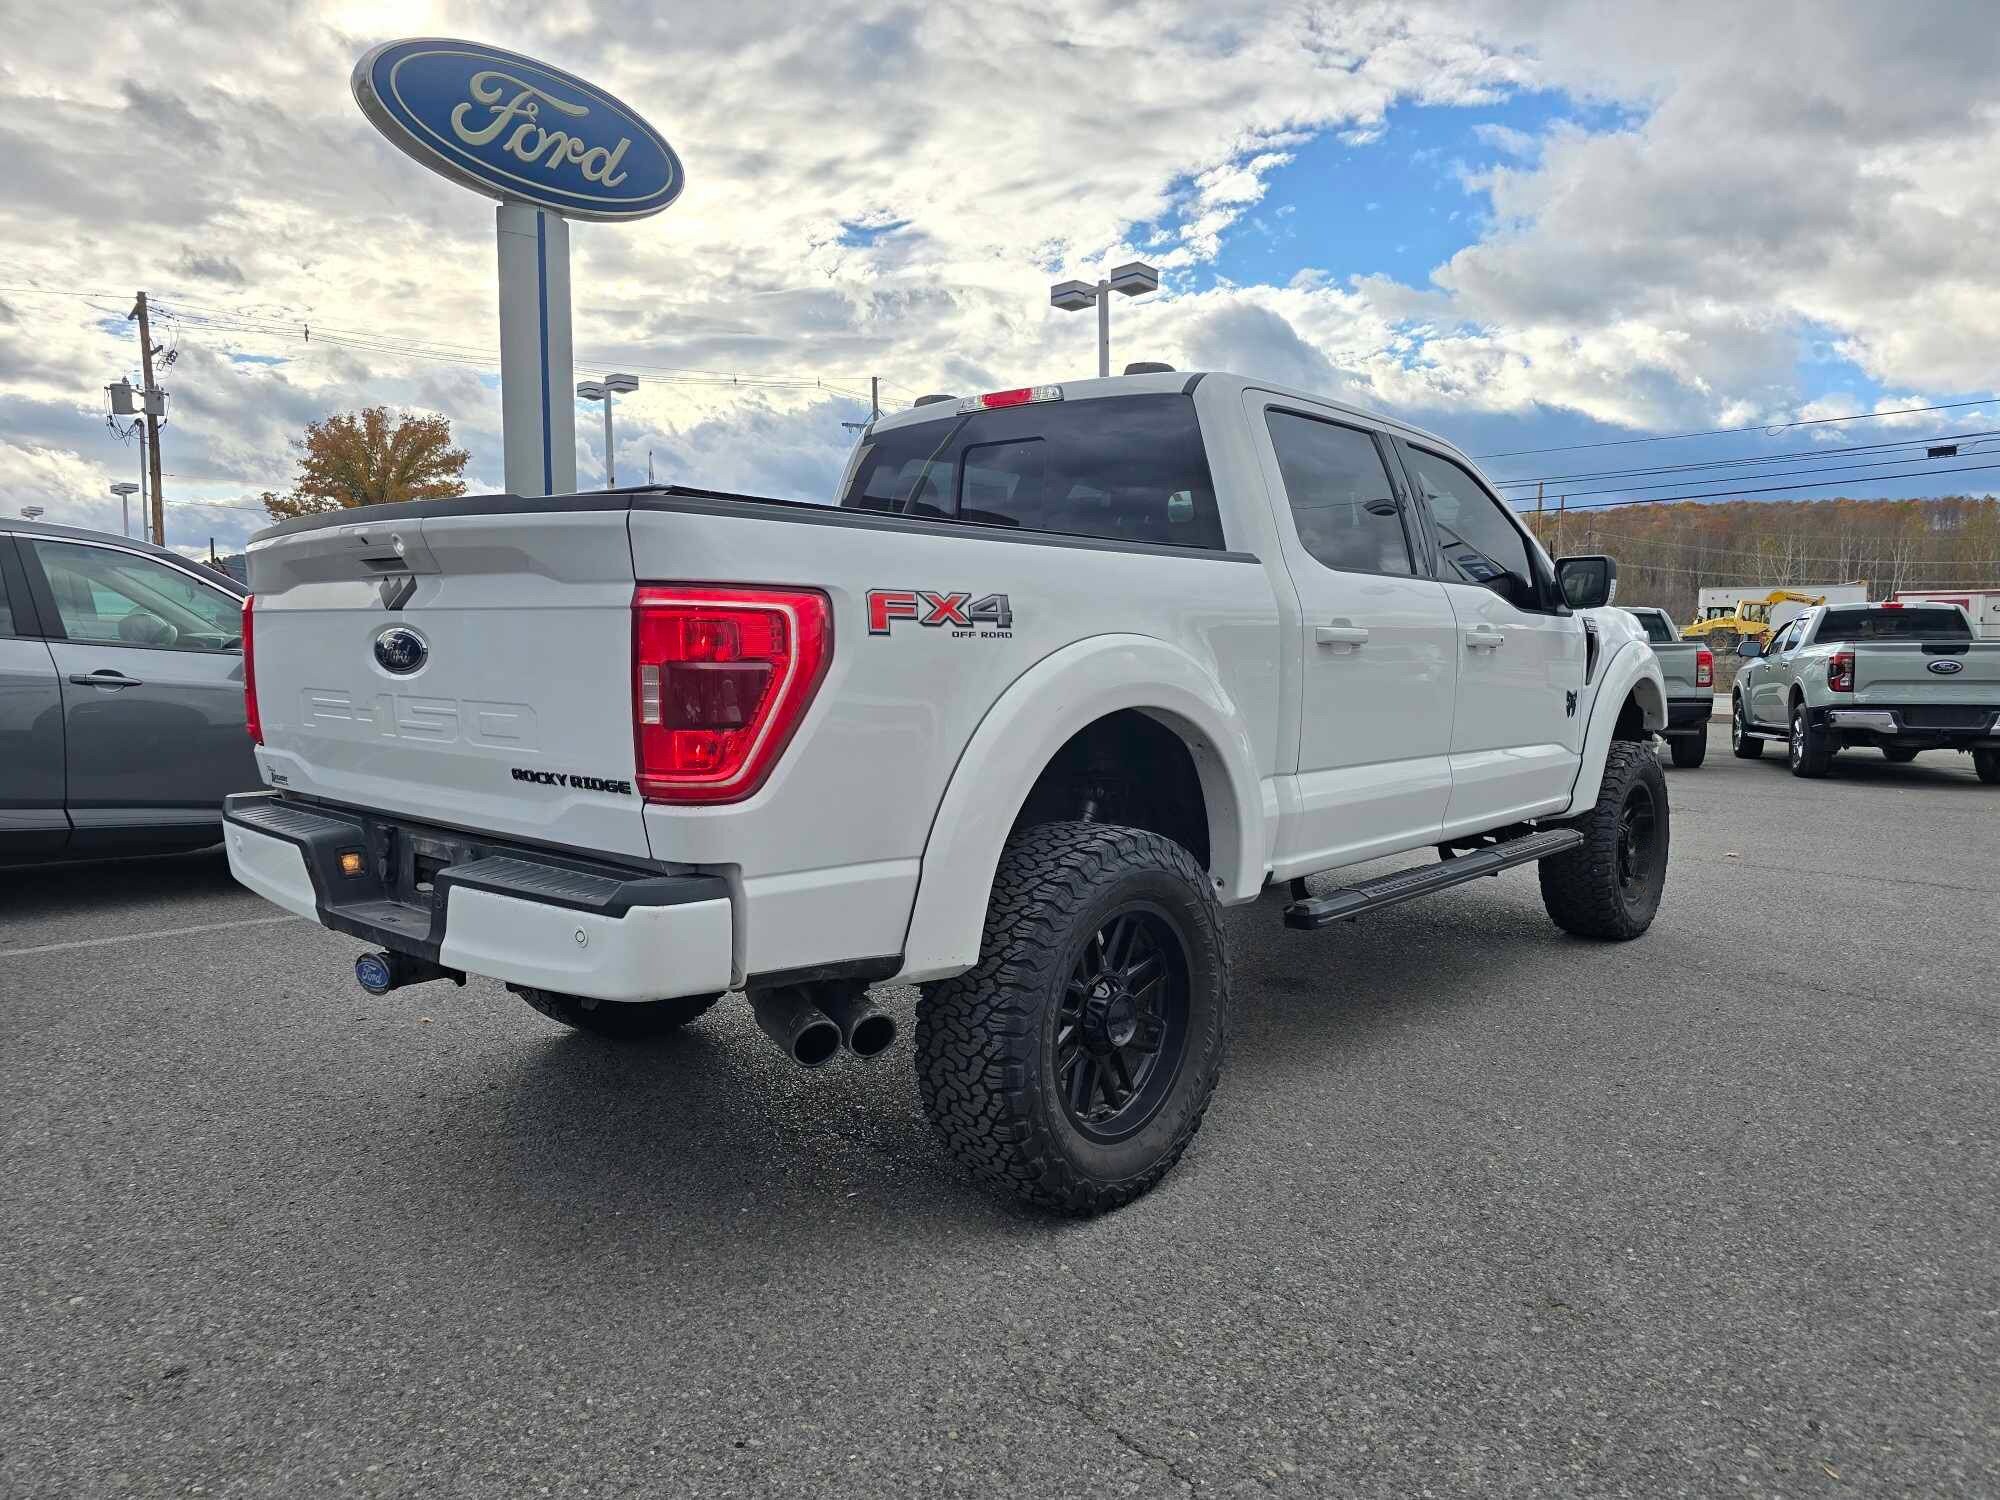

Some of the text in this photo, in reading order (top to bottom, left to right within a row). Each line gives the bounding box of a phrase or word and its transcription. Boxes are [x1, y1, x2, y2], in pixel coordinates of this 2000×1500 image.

[451, 71, 631, 188] Ford
[865, 588, 1013, 636] FX4
[951, 631, 1013, 639] OFF ROAD
[301, 686, 544, 753] F-150
[511, 767, 632, 795] ROCKY RIDGE
[361, 963, 385, 985] Ford
